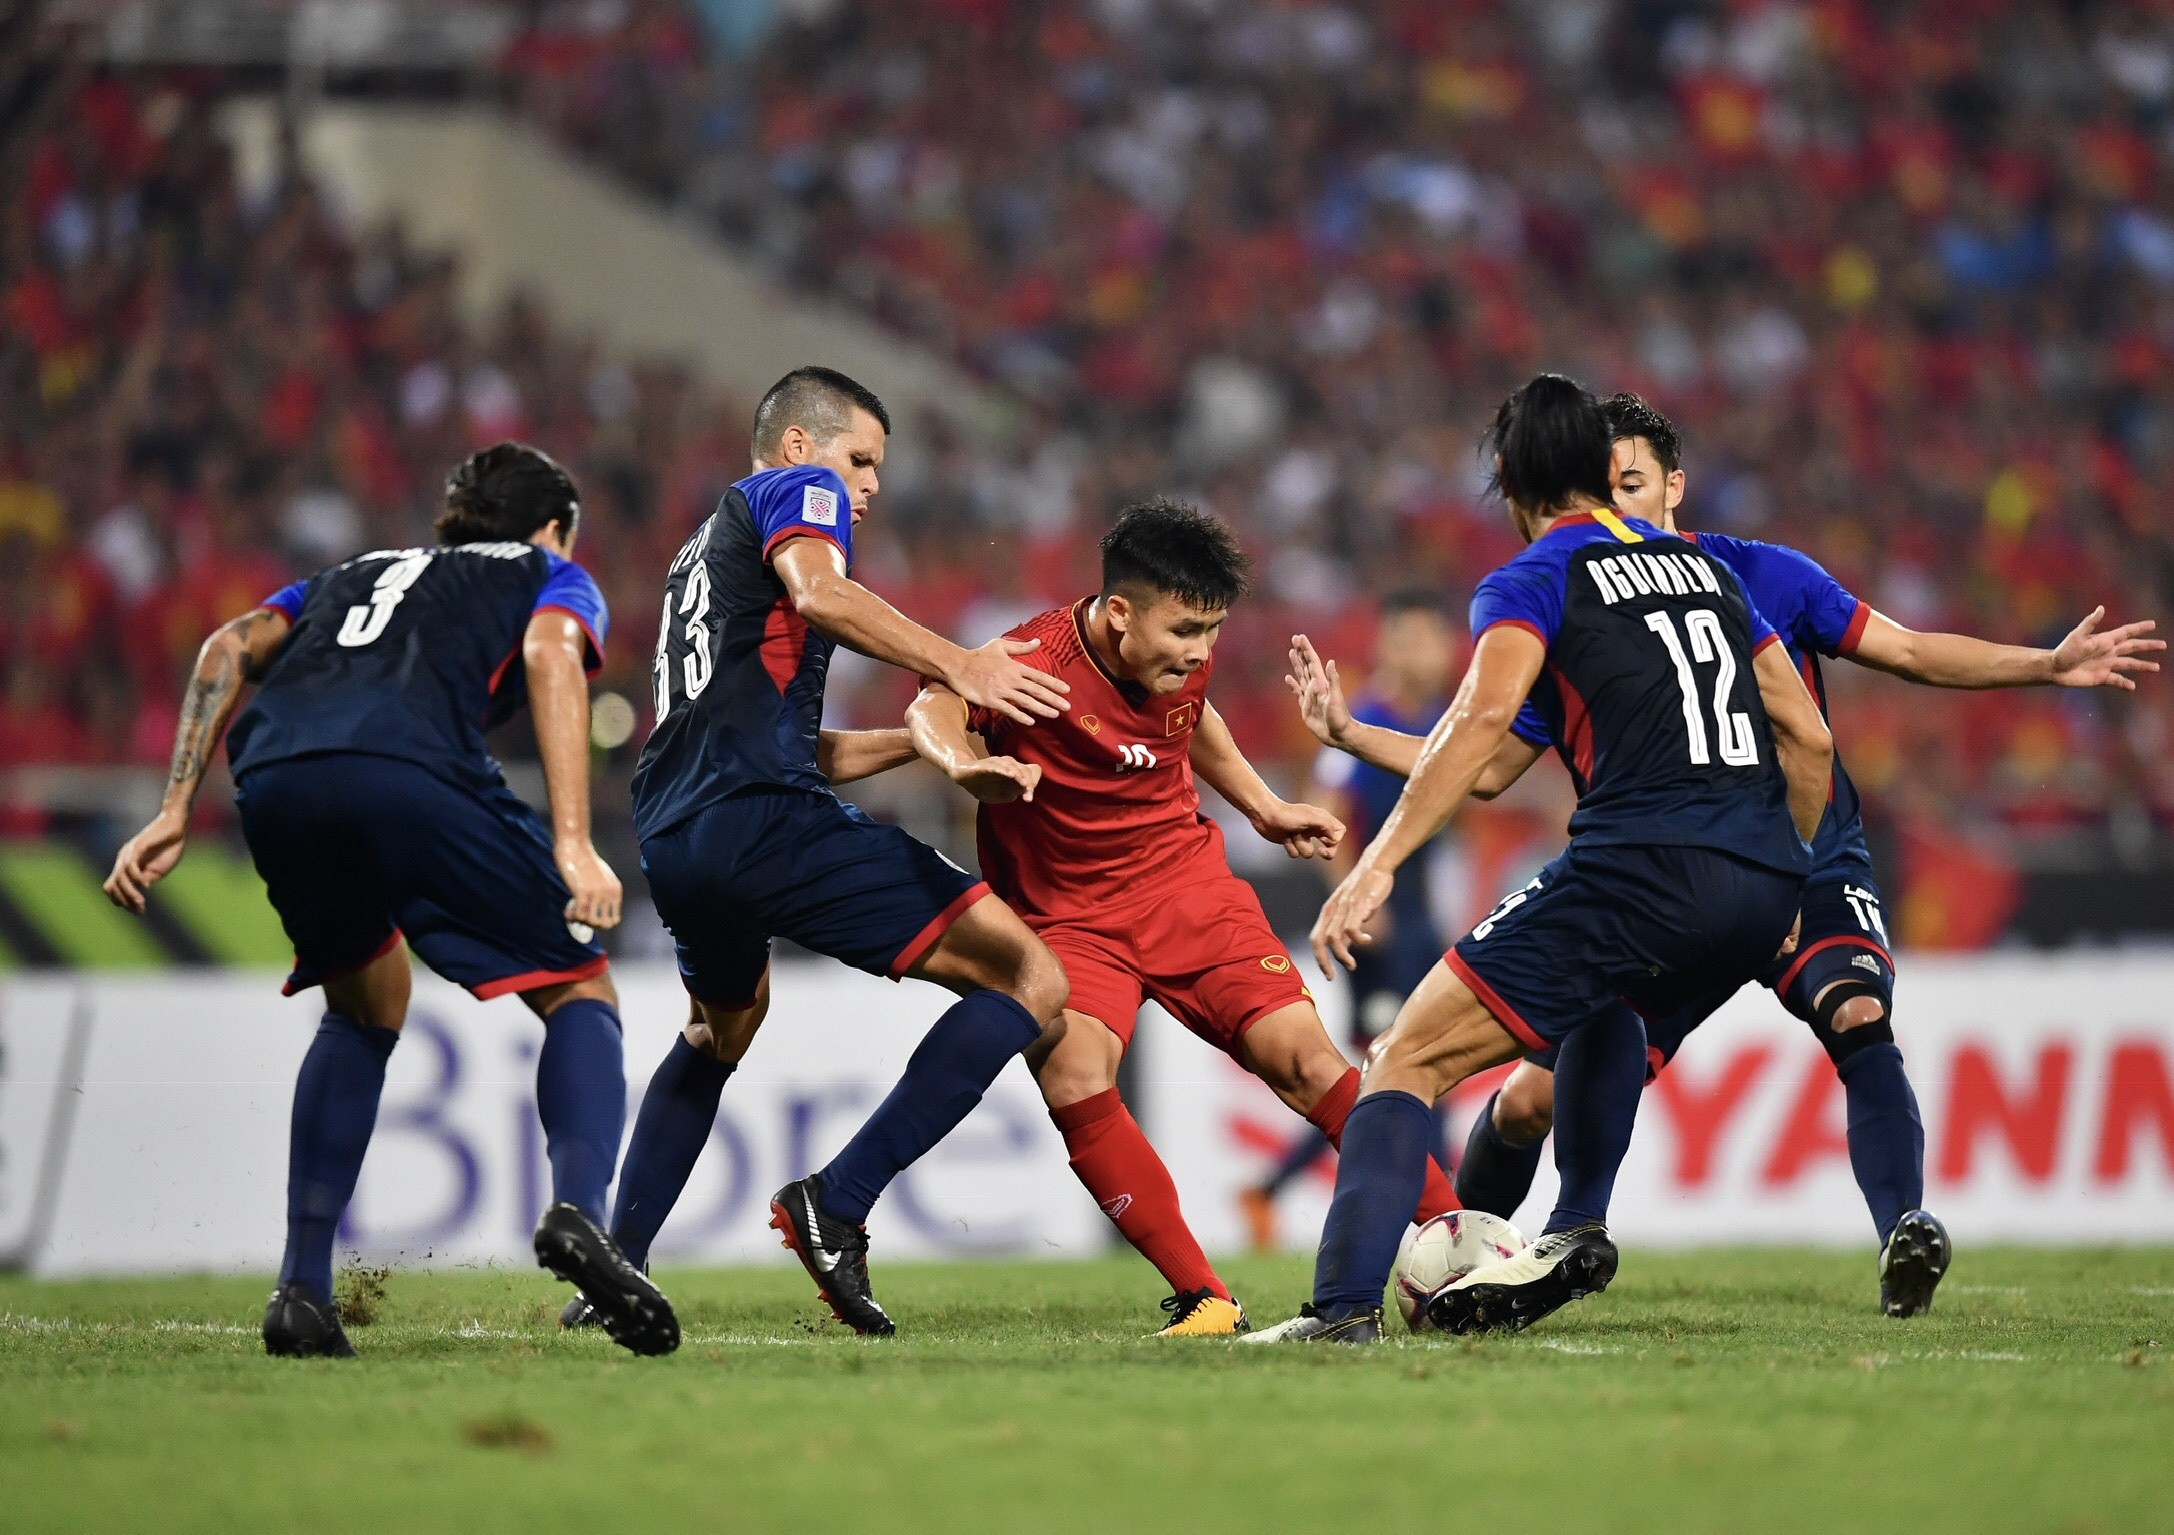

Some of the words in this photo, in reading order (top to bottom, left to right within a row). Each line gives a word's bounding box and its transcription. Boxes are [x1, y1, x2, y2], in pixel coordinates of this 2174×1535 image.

[336, 554, 433, 647] 3
[1586, 552, 1722, 605] AGUINALD
[1643, 609, 1760, 766] 12
